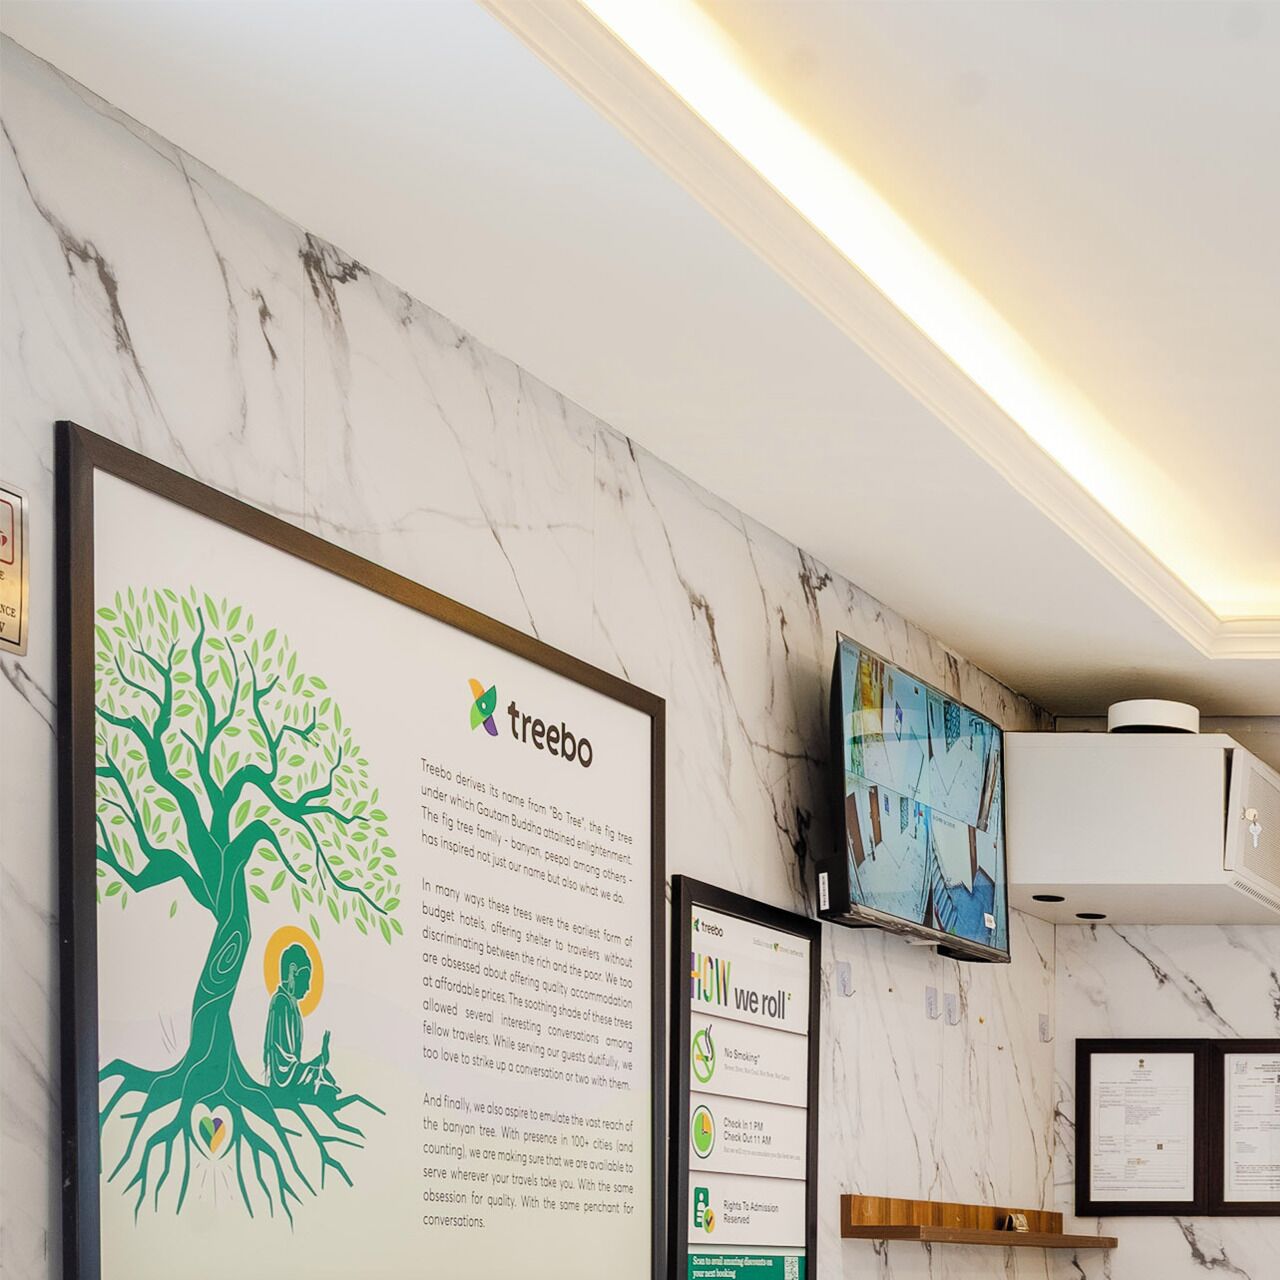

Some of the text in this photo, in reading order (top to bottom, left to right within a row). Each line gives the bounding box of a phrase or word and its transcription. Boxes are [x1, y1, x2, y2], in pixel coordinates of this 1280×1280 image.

[507, 701, 593, 768] treebo
[421, 757, 452, 781] Treebo
[456, 772, 486, 793] derives
[489, 783, 499, 798] its
[502, 791, 525, 808] name
[528, 797, 546, 814] from
[589, 821, 602, 835] the
[605, 824, 615, 842] fig
[618, 832, 633, 845] tree
[421, 786, 448, 802] under
[449, 794, 475, 812] which
[476, 801, 510, 824] Gautam
[511, 813, 542, 836] Buddha
[543, 828, 575, 847] attained
[421, 805, 439, 823] The
[442, 812, 453, 831] fig
[457, 820, 474, 835] tree
[476, 823, 501, 847] family
[545, 851, 570, 870] peepal
[573, 860, 600, 879] among
[602, 868, 626, 884] others
[422, 877, 633, 947] In many ways these trees were the earliest form of
[422, 901, 455, 923] budget
[491, 921, 521, 943] offering
[526, 931, 551, 947] shelter
[555, 939, 564, 951] to
[567, 942, 600, 961] travelers
[605, 952, 632, 968] without
[701, 920, 724, 937] treebo
[422, 926, 484, 956] discriminating
[486, 942, 520, 961] between
[522, 952, 535, 966] the
[536, 957, 551, 969] rich
[553, 962, 567, 974] and
[569, 965, 582, 977] the
[605, 972, 618, 986] We
[620, 976, 633, 989] too
[423, 952, 632, 1008] are obsessed about offering quality accommodation
[423, 976, 433, 988] at
[435, 976, 480, 998] affordable
[508, 992, 523, 1007] The
[524, 999, 557, 1018] soothing
[558, 1004, 581, 1020] shade
[583, 1009, 591, 1021] of
[592, 1011, 613, 1026] these
[614, 1017, 633, 1030] trees
[691, 951, 785, 1019] HOW we roll
[422, 998, 633, 1053] allowed several interesting conversations among
[423, 1020, 450, 1037] fellow
[493, 1034, 515, 1050] While
[517, 1042, 545, 1059] serving
[547, 1047, 560, 1058] our
[561, 1050, 586, 1063] guests
[622, 1061, 633, 1071] we
[724, 1047, 733, 1058] No
[423, 1116, 438, 1131] the
[443, 1118, 475, 1137] banyan
[501, 1126, 520, 1140] With
[523, 1132, 557, 1145] presence
[561, 1133, 568, 1145] in
[571, 1135, 589, 1148] 100+
[593, 1138, 613, 1151] cities
[616, 1140, 633, 1153] (and
[723, 1117, 742, 1129] Check
[753, 1120, 764, 1131] PM
[723, 1130, 742, 1142] Check
[742, 1132, 753, 1143] Out
[761, 1135, 772, 1145] AM
[423, 1167, 447, 1179] serve
[450, 1167, 489, 1182] wherever
[491, 1174, 509, 1185] your
[512, 1173, 538, 1186] travels
[540, 1176, 557, 1188] take
[577, 1178, 596, 1191] With
[598, 1182, 611, 1192] the
[613, 1184, 634, 1194] same
[469, 1149, 481, 1159] we
[482, 1150, 496, 1160] are
[498, 1149, 527, 1166] making
[528, 1154, 545, 1165] sure
[546, 1154, 562, 1167] that
[564, 1159, 574, 1168] we
[575, 1159, 588, 1169] are
[589, 1160, 624, 1172] available
[625, 1163, 634, 1173] to
[423, 1188, 467, 1204] obsession
[471, 1190, 483, 1205] for
[521, 1195, 539, 1208] With
[543, 1197, 556, 1210] the
[559, 1201, 580, 1211] same
[583, 1201, 620, 1216] penchant
[623, 1201, 634, 1214] for
[723, 1199, 779, 1212] Rights To Admission
[723, 1213, 750, 1224] Reserved
